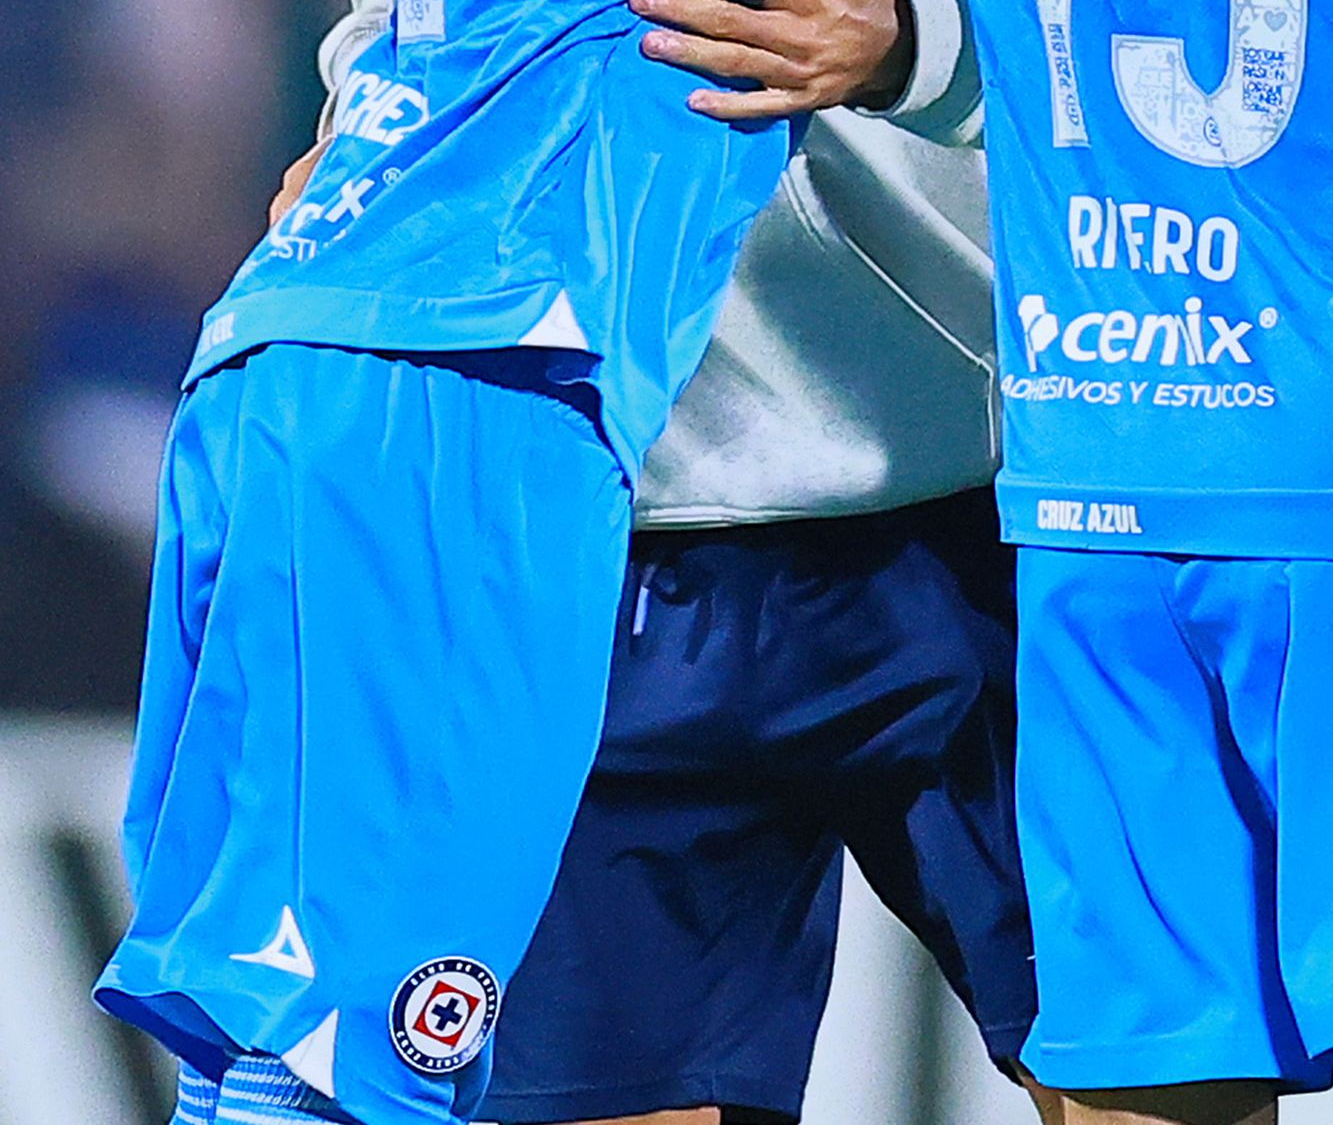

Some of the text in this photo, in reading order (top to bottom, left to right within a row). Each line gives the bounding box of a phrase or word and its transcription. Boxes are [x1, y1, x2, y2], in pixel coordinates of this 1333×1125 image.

[1000, 373, 1275, 409] ADHESIVOS Y ESTUCOS
[1037, 499, 1143, 534] CRUZ AZUL
